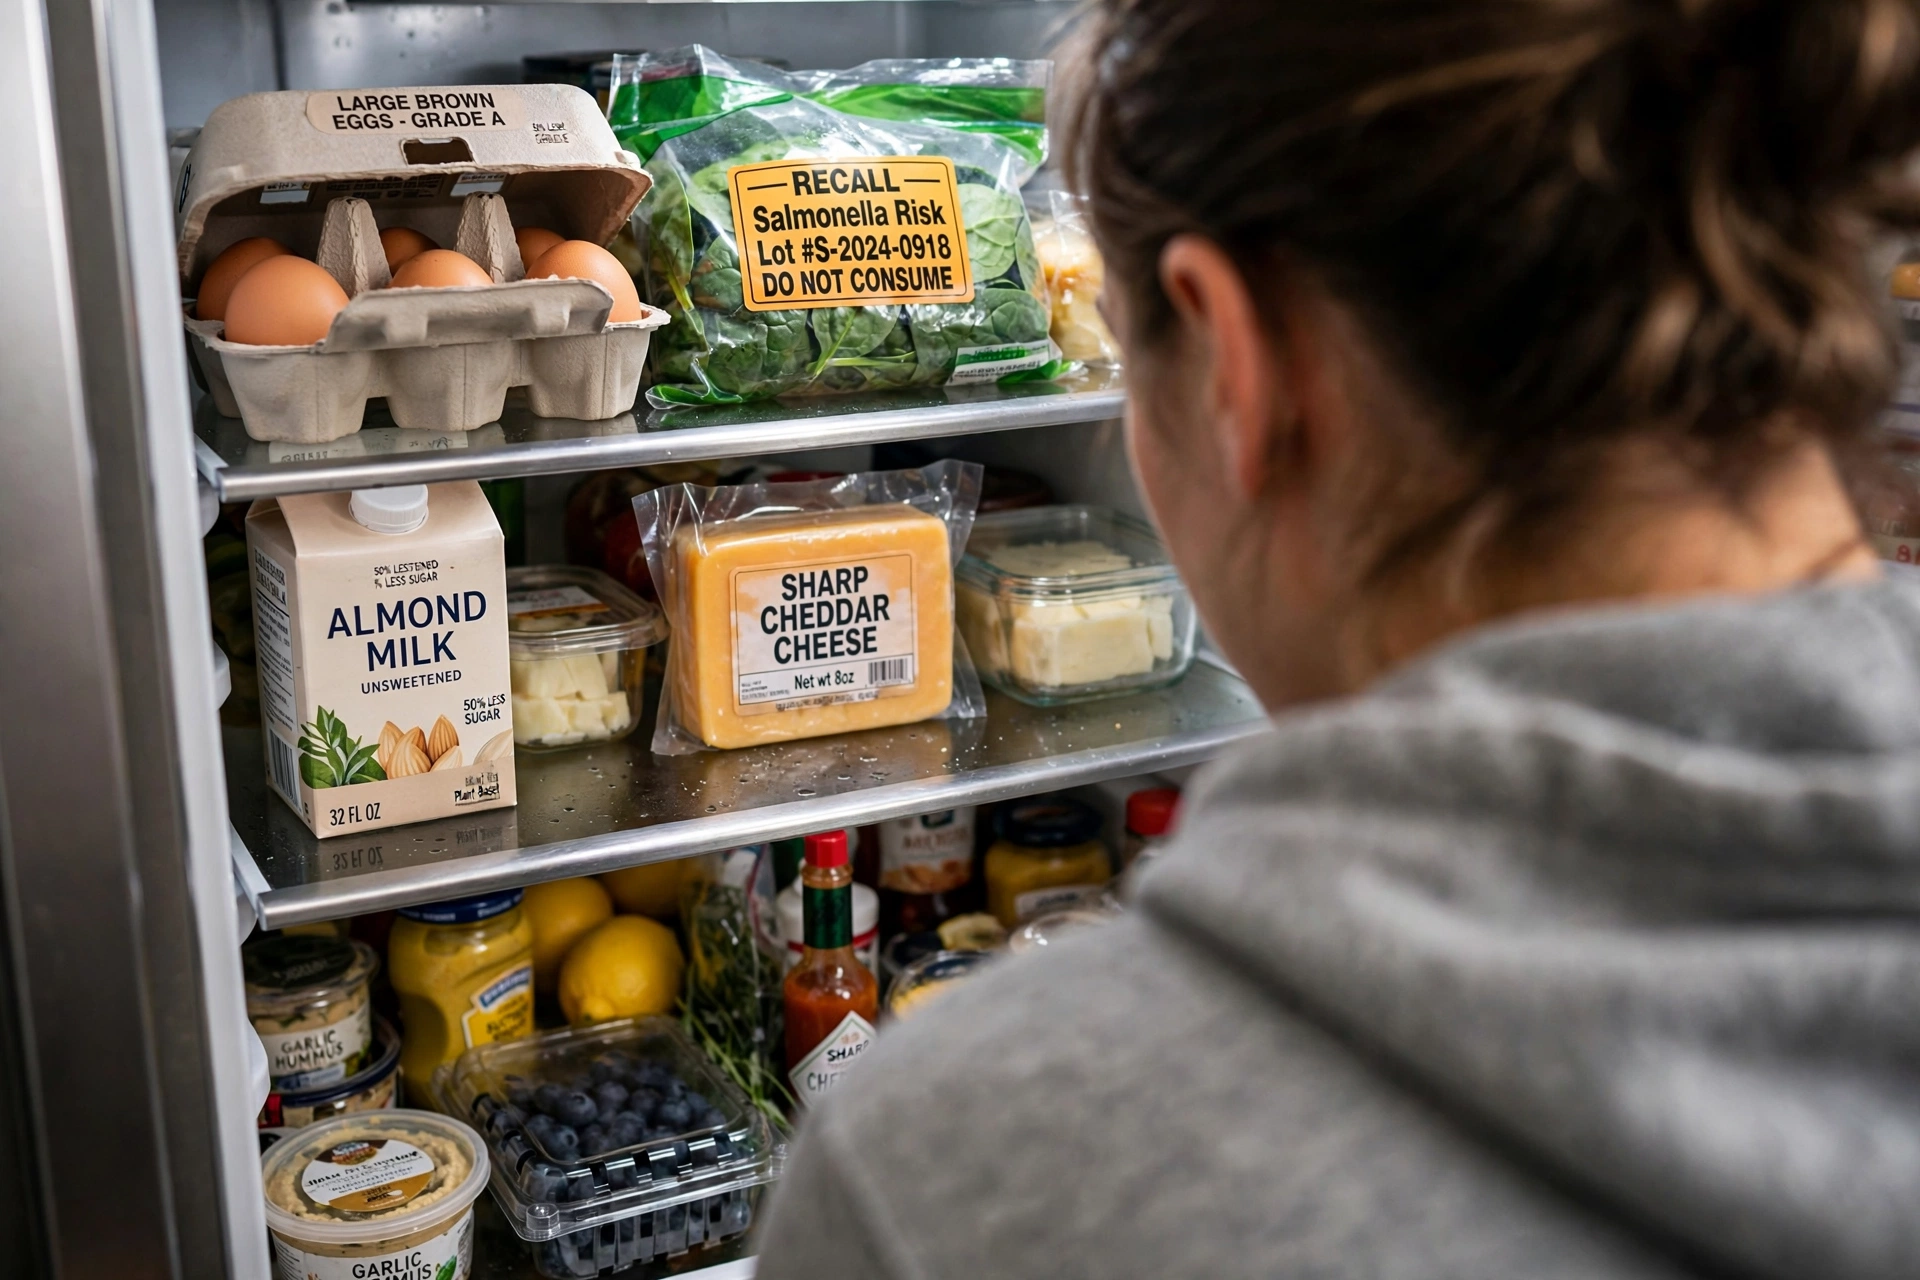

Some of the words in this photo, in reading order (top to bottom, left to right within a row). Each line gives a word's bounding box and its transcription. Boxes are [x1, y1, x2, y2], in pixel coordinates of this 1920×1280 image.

[337, 95, 411, 111] LARGE
[415, 93, 495, 109] BROWN
[332, 113, 394, 129] EGGS
[411, 112, 485, 128] GRADE
[492, 111, 506, 126] A
[792, 168, 900, 196] RECALL
[753, 200, 889, 233] Salmonella
[894, 199, 946, 225] Risk
[757, 239, 796, 266] Lot
[802, 234, 952, 263] #S-2024-0918
[762, 271, 795, 297] DO
[801, 269, 843, 295] NOT
[850, 266, 953, 292] CONSUME
[385, 575, 406, 588] LESS
[409, 571, 438, 585] SUGAR
[781, 566, 869, 601] SHARP
[327, 590, 487, 639] ALMOND
[760, 594, 890, 635] CHEDDAR
[367, 630, 457, 672] MILK
[774, 626, 878, 664] CHEESE
[361, 669, 462, 694] UNSWEETENED
[794, 674, 815, 690] Net
[818, 670, 831, 688] wt
[834, 670, 855, 684] 8oz
[487, 693, 506, 707] LESS
[464, 708, 501, 725] SUGAR
[329, 808, 346, 827] 32
[348, 804, 363, 824] FL
[365, 802, 381, 821] OZ
[275, 1041, 344, 1069] HUMMUS
[281, 1029, 336, 1053] GARLIC
[352, 1251, 421, 1279] GARLIC
